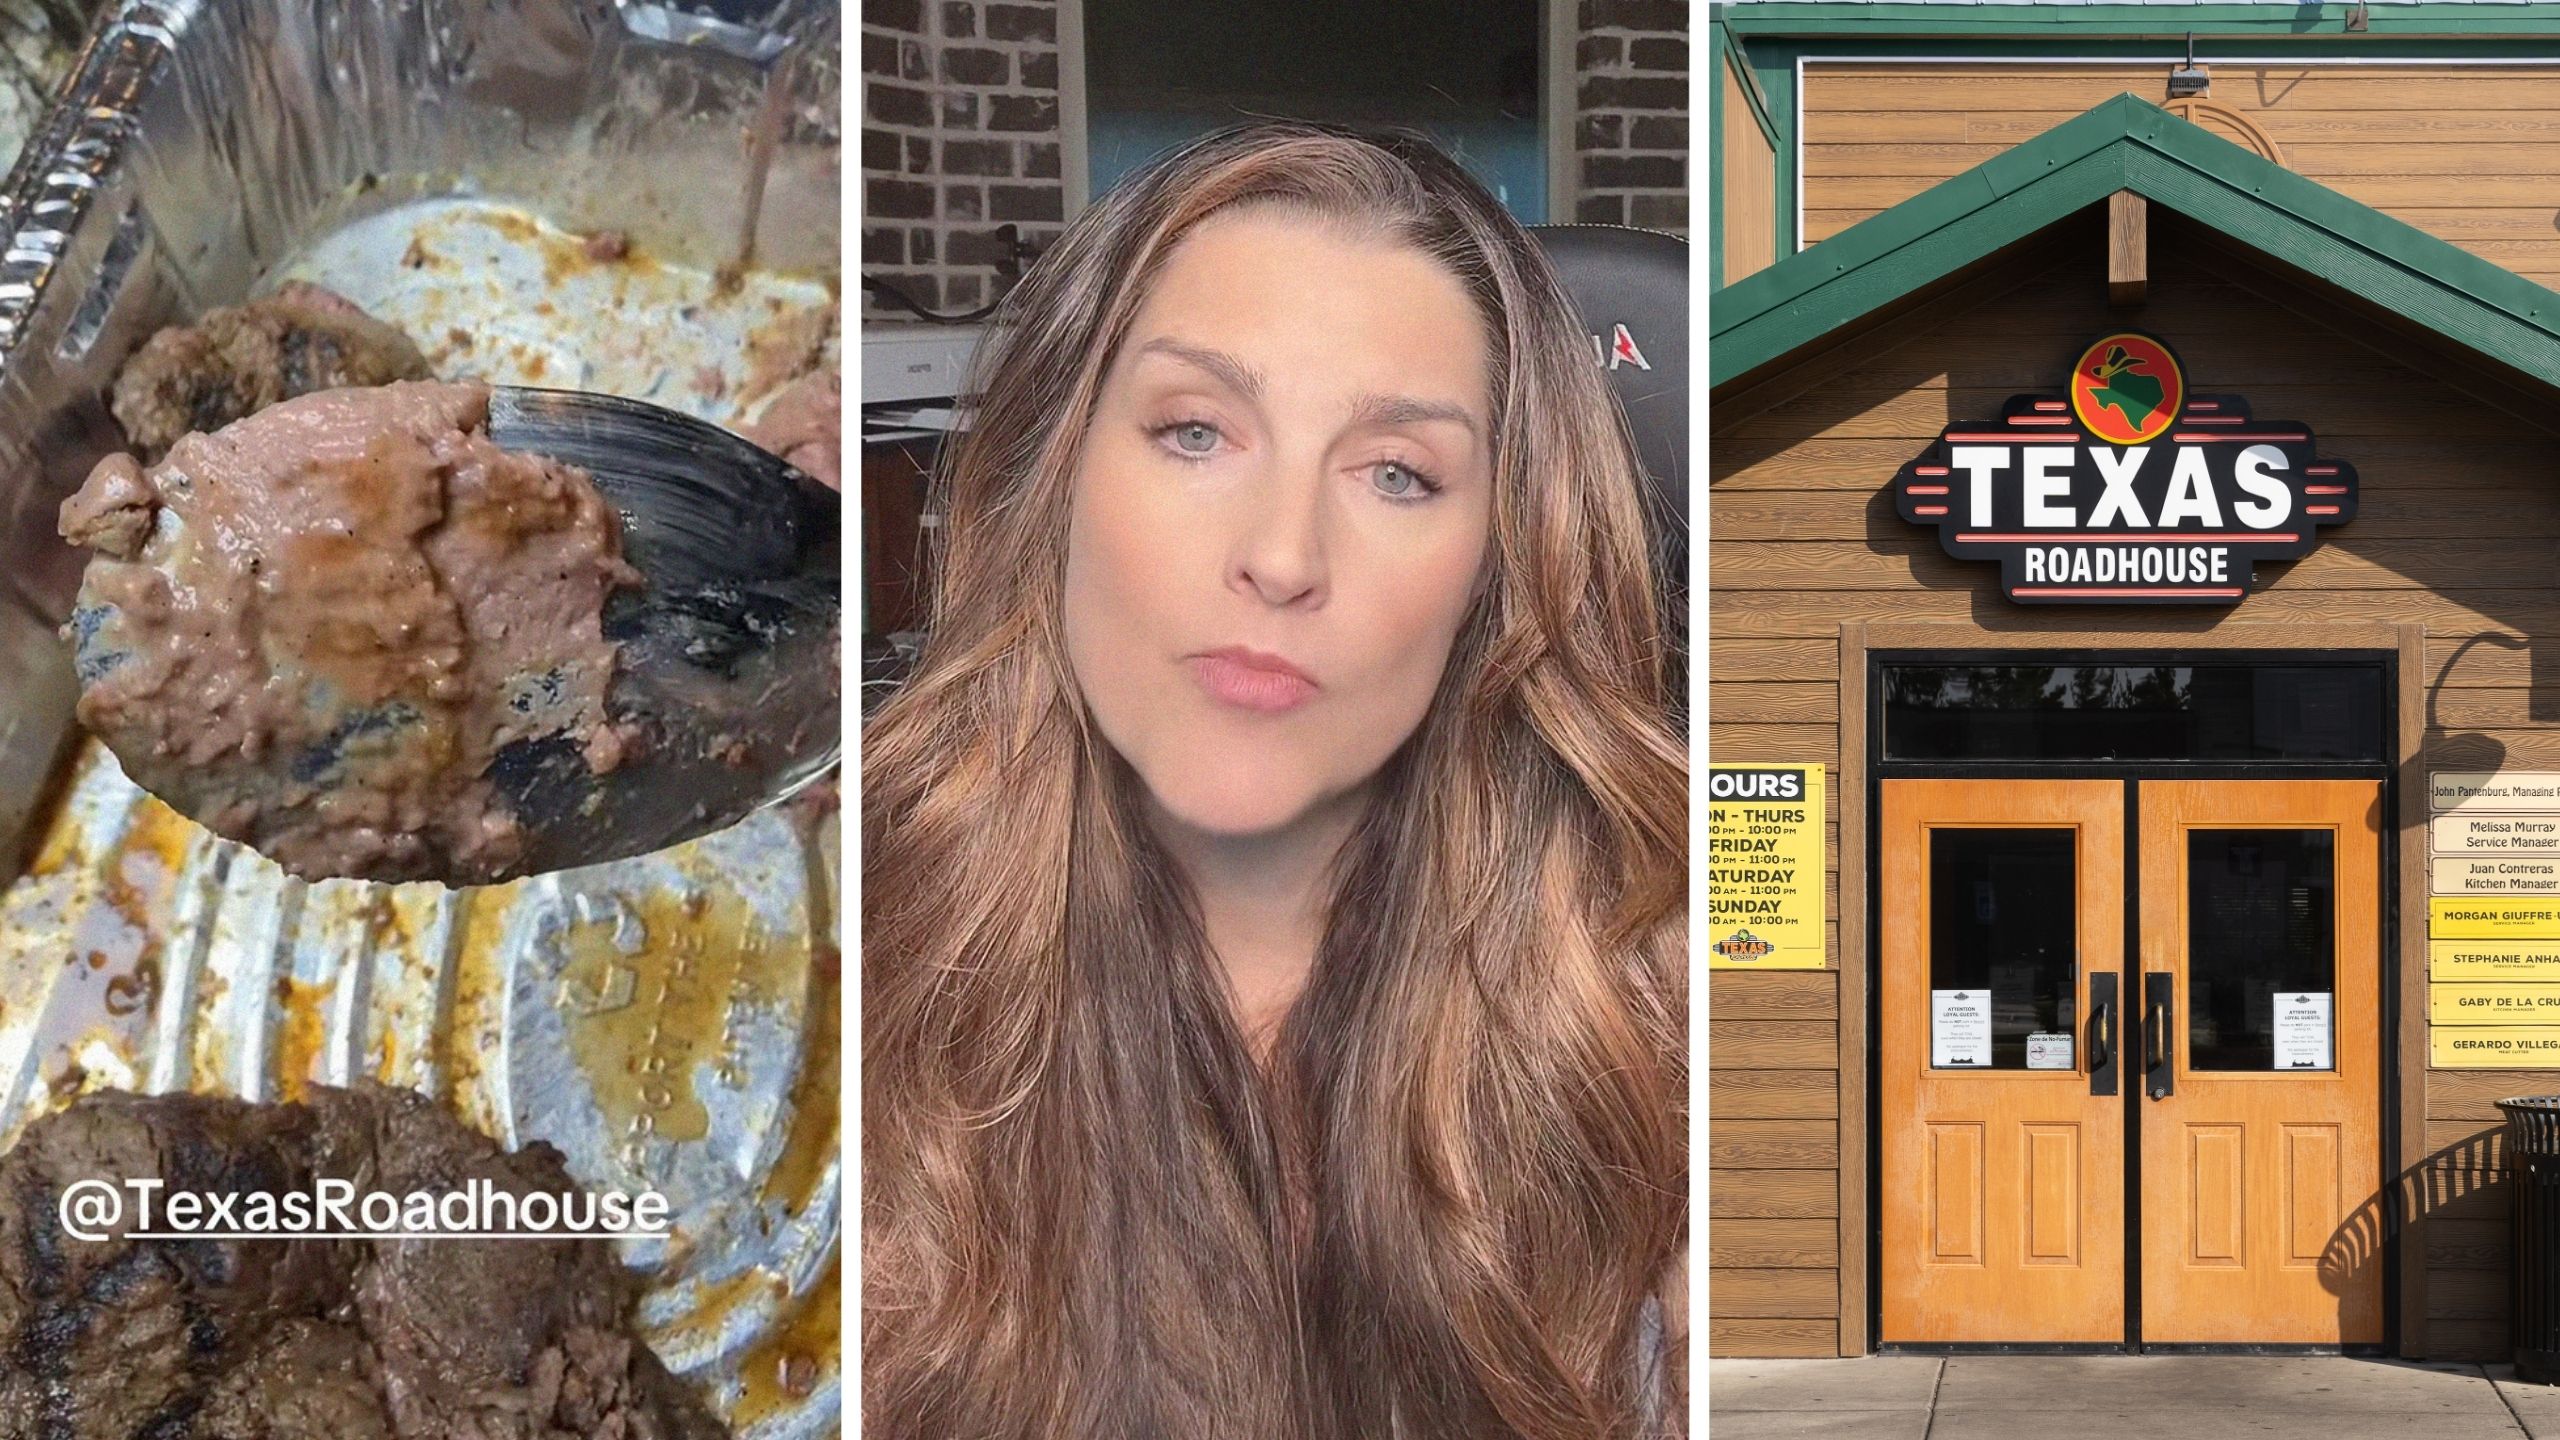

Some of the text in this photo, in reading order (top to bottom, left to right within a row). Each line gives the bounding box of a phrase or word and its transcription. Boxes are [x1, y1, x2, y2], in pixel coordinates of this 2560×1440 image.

[1951, 444, 2293, 530] TEXAS
[2025, 546, 2228, 583] ROADHOUSE
[1710, 773, 1799, 797] OURS
[2434, 786, 2455, 797] John
[2512, 786, 2554, 797] Managing
[1709, 810, 1725, 822] N
[1743, 810, 1805, 822] THURS
[1748, 825, 1781, 834] 10:00
[2470, 822, 2556, 833] Melissa Murray
[1709, 839, 1778, 852] FRIDAY
[2466, 837, 2559, 848] Service Manager
[1749, 855, 1780, 864] 11:00
[2469, 864, 2554, 874] Juan Contreras
[1709, 870, 1795, 883] ATURDAY
[2465, 879, 2559, 889] Kitchen Manager
[1750, 886, 1781, 895] 11:00
[1709, 900, 1782, 913] SUNDAY
[1749, 916, 1783, 925] 10:00
[2444, 911, 2498, 920] MORGAN
[1721, 942, 1766, 954] TEXAS
[2453, 954, 2521, 963] STEPHANIE
[2459, 998, 2492, 1006] GABY
[2496, 998, 2512, 1006] DE
[2517, 998, 2533, 1006] LA
[2453, 1040, 2560, 1049] GERARDO VILLEG
